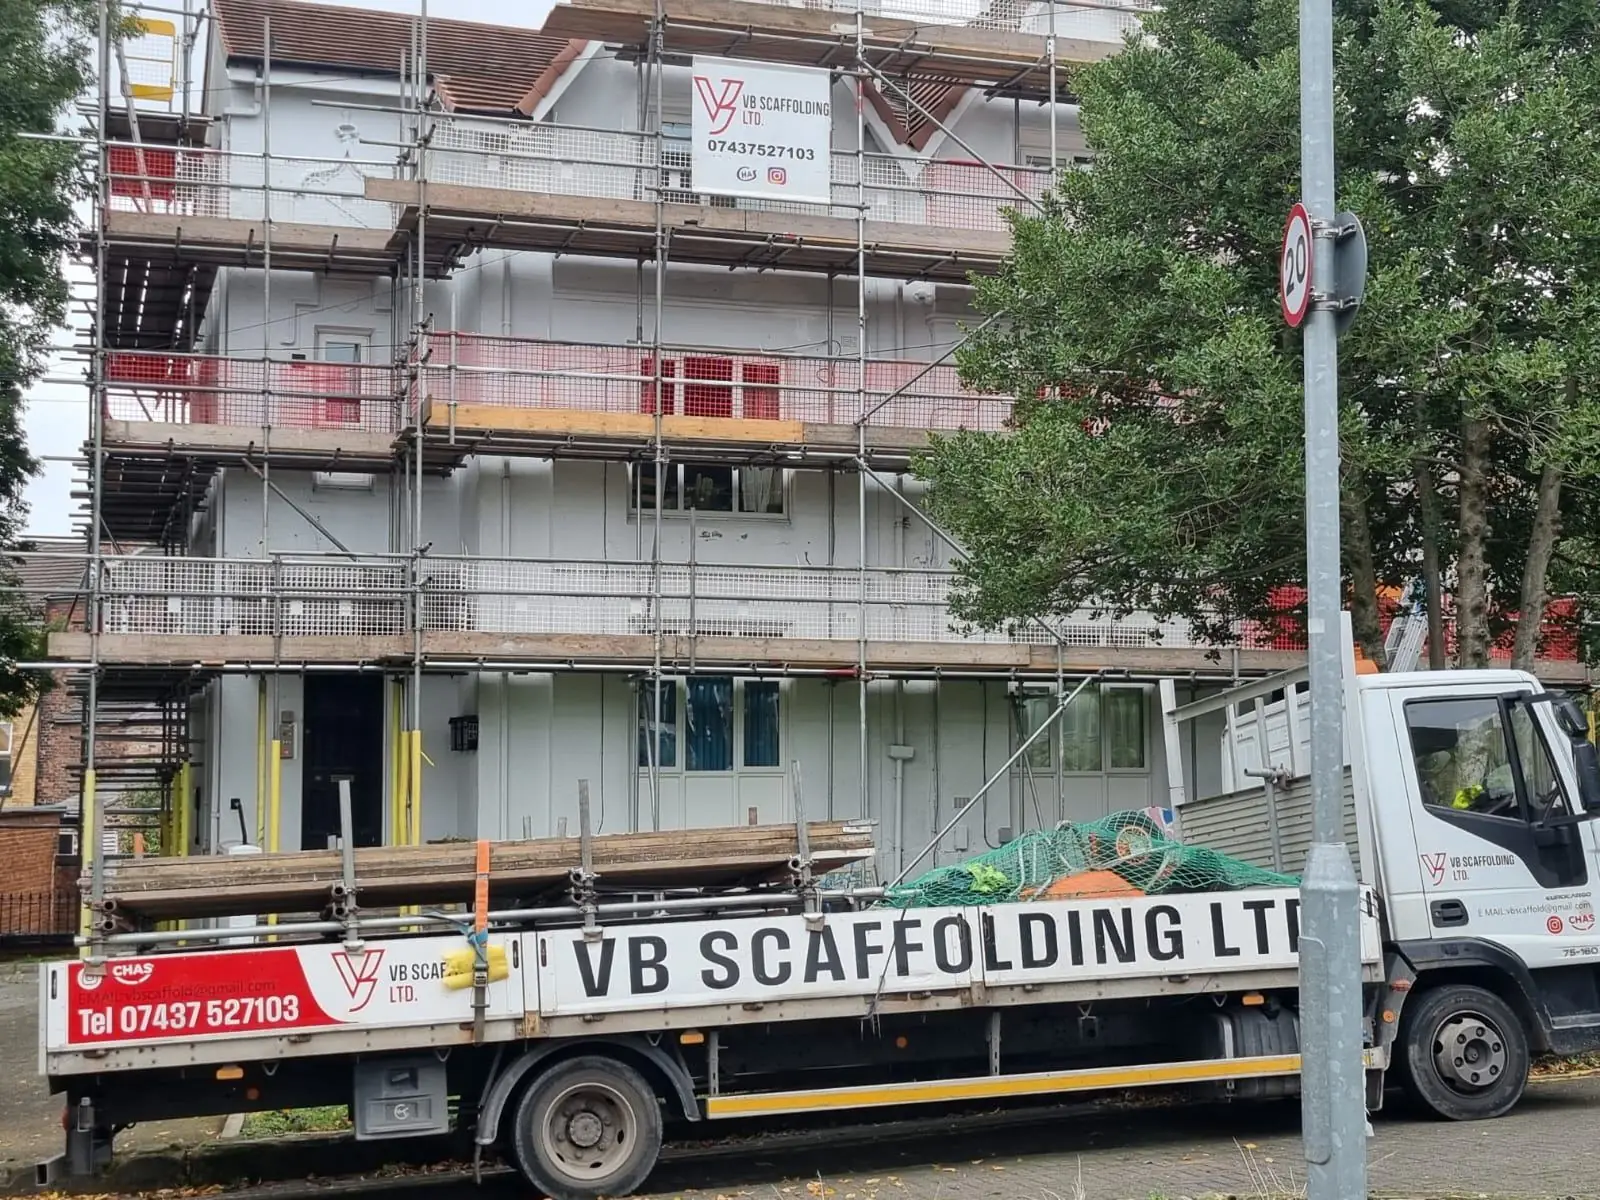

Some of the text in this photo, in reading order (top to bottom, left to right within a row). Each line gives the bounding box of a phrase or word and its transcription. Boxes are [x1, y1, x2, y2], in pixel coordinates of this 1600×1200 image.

[742, 94, 830, 117] VB SCAFFOLDING
[742, 110, 764, 126] LTD.
[708, 139, 815, 161] 07437527103
[1285, 234, 1306, 297] 20
[1450, 854, 1515, 868] VB SCAFFOLDING
[1453, 869, 1470, 881] LTD.
[1568, 914, 1596, 925] CHAS
[572, 934, 670, 998] VB
[699, 903, 1185, 990] SCAFFOLDING
[112, 962, 154, 977] CHAS
[389, 964, 408, 982] VB
[389, 985, 418, 1003] LTD.
[78, 994, 299, 1036] Tel 07437 527103
